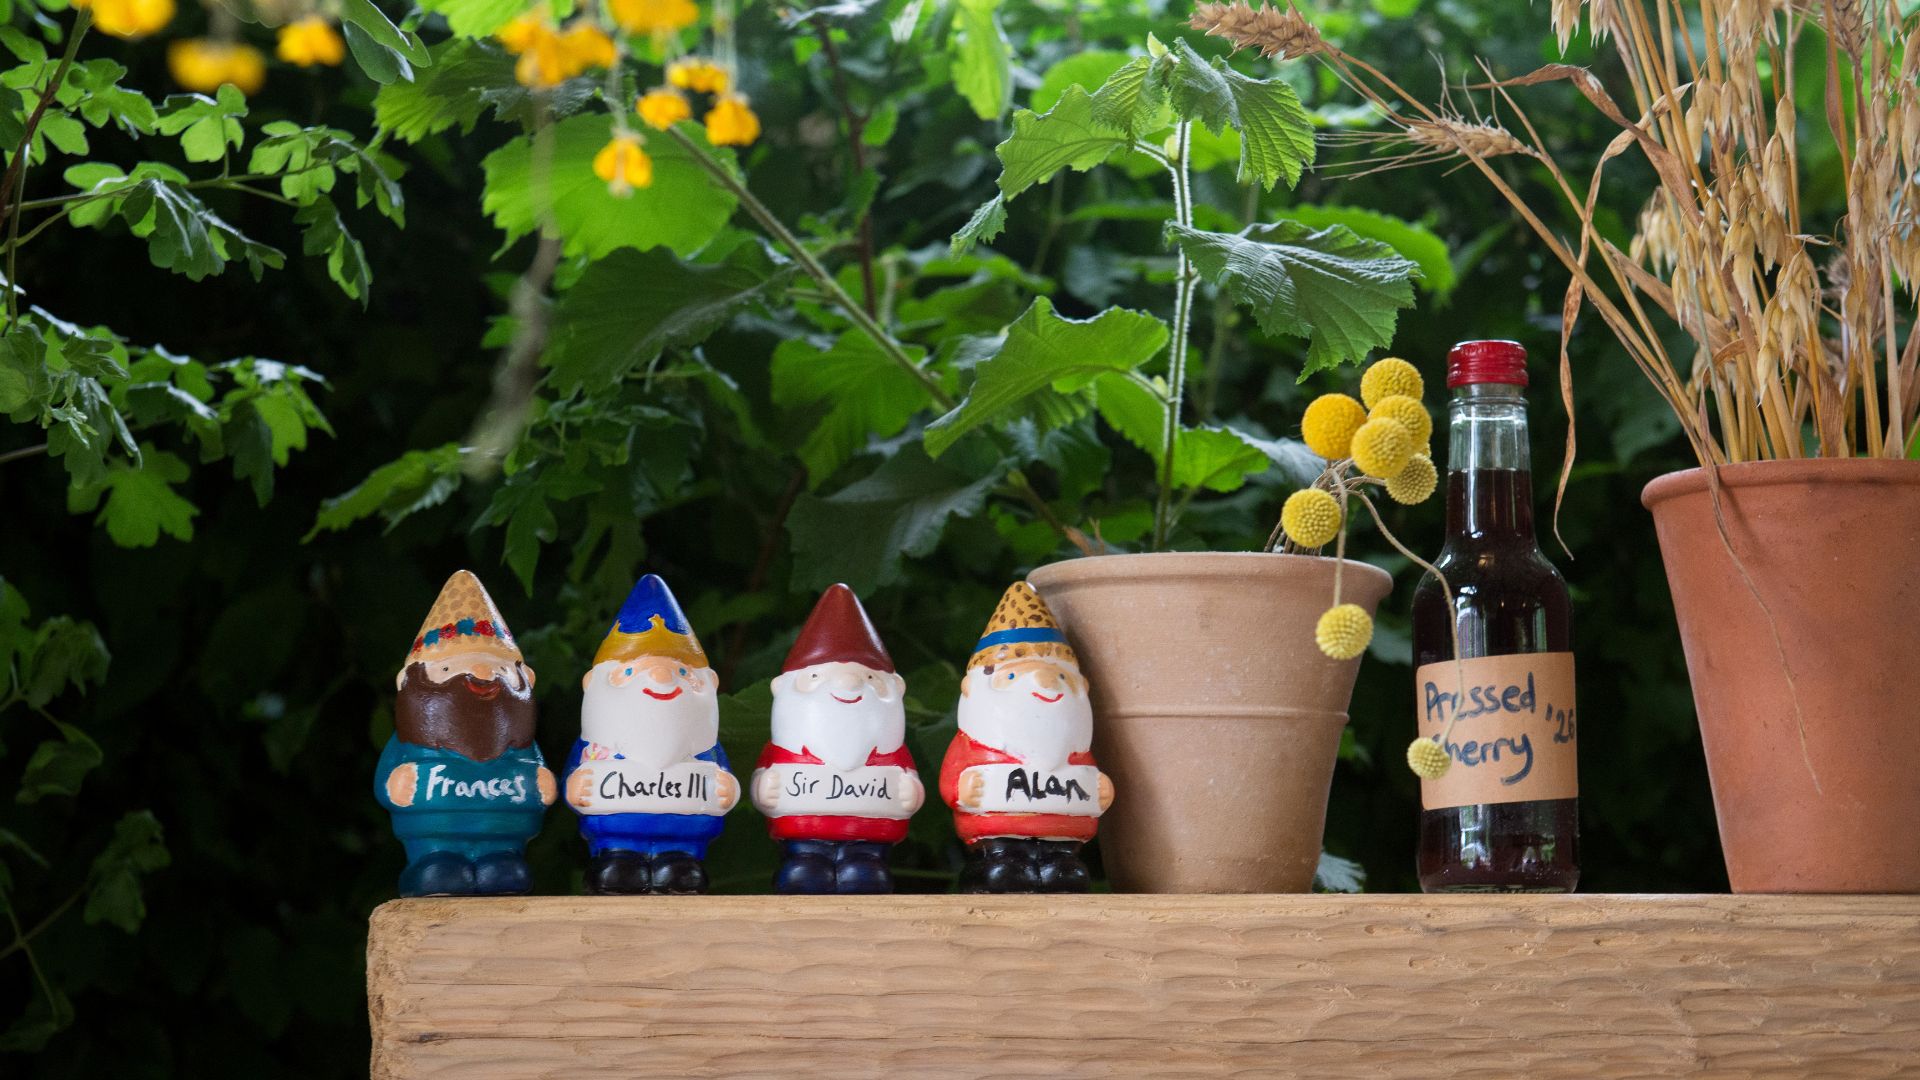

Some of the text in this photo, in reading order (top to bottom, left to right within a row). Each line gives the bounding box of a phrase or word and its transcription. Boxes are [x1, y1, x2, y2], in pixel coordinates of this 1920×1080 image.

[1432, 734, 1533, 785] herry
[426, 765, 525, 801] Frances
[600, 771, 682, 799] Charles
[786, 771, 892, 800] Sir David
